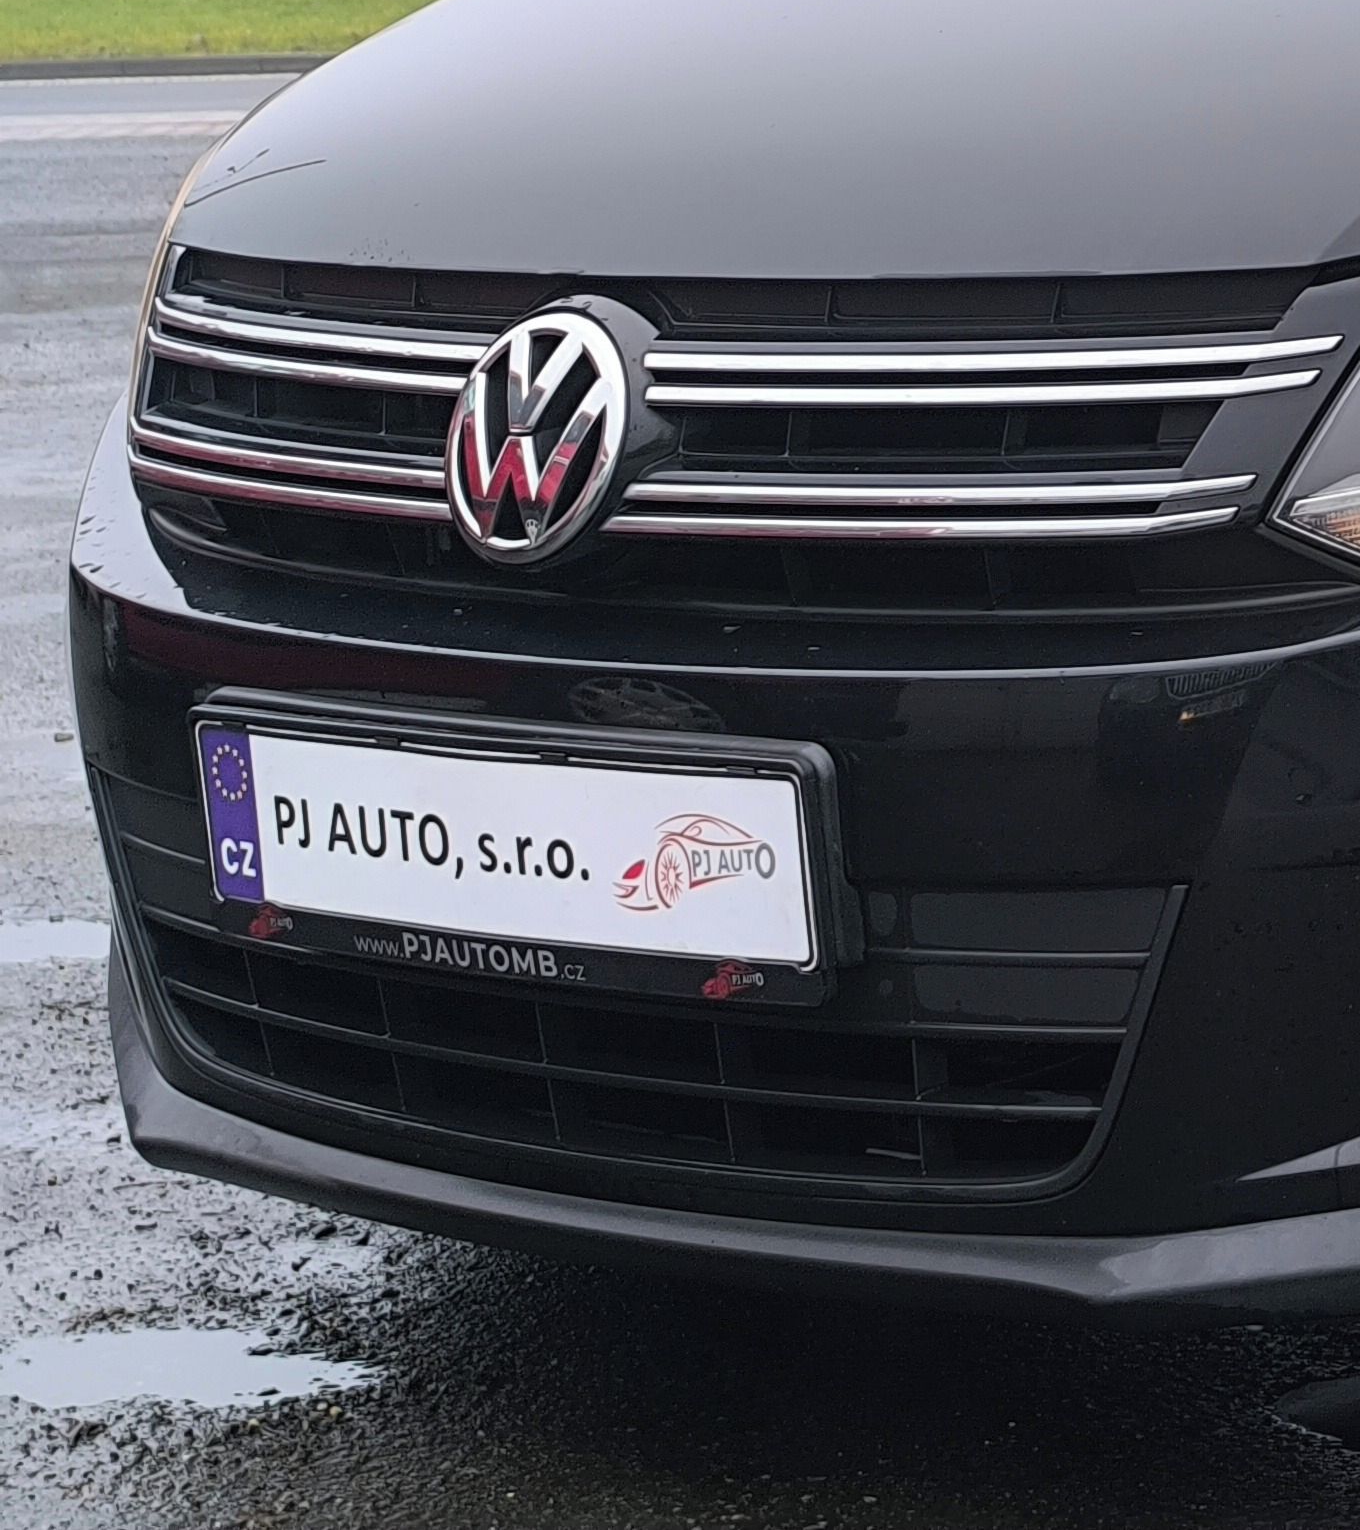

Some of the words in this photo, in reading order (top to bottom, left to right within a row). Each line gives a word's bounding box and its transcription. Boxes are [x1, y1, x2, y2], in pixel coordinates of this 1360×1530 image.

[219, 836, 258, 879] CZ
[273, 794, 311, 849] PJ
[328, 802, 464, 881] AUTO,
[477, 832, 591, 882] s.r.o.
[690, 849, 712, 877] PJ
[717, 842, 776, 880] AUTO
